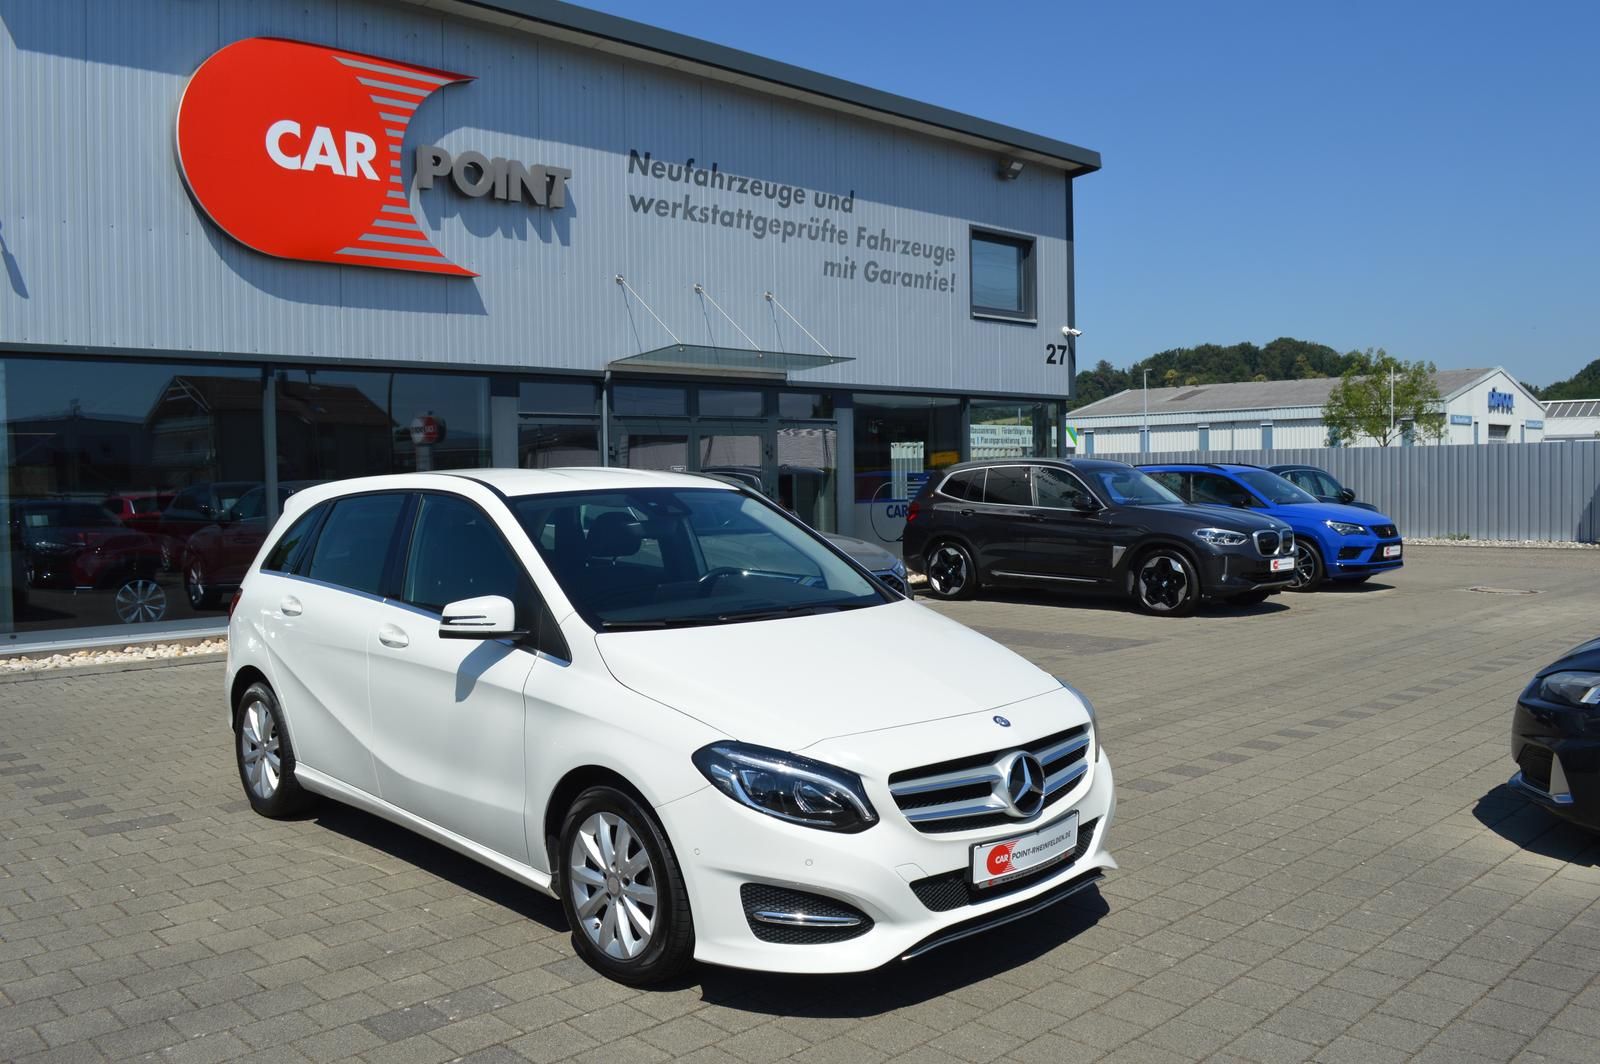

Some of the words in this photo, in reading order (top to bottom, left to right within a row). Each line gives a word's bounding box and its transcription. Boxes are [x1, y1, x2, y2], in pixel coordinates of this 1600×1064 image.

[265, 119, 380, 181] CAR
[416, 145, 572, 209] POINT
[628, 149, 805, 208] Neufahrzeuge
[814, 190, 855, 213] und
[629, 193, 849, 245] werkstattgeprüfte
[856, 227, 956, 266] Fahrzeuge
[824, 255, 856, 279] mit
[864, 260, 956, 293] Garantie!
[1046, 343, 1067, 365] 27
[886, 504, 909, 518] CAR
[995, 853, 1009, 864] CAR
